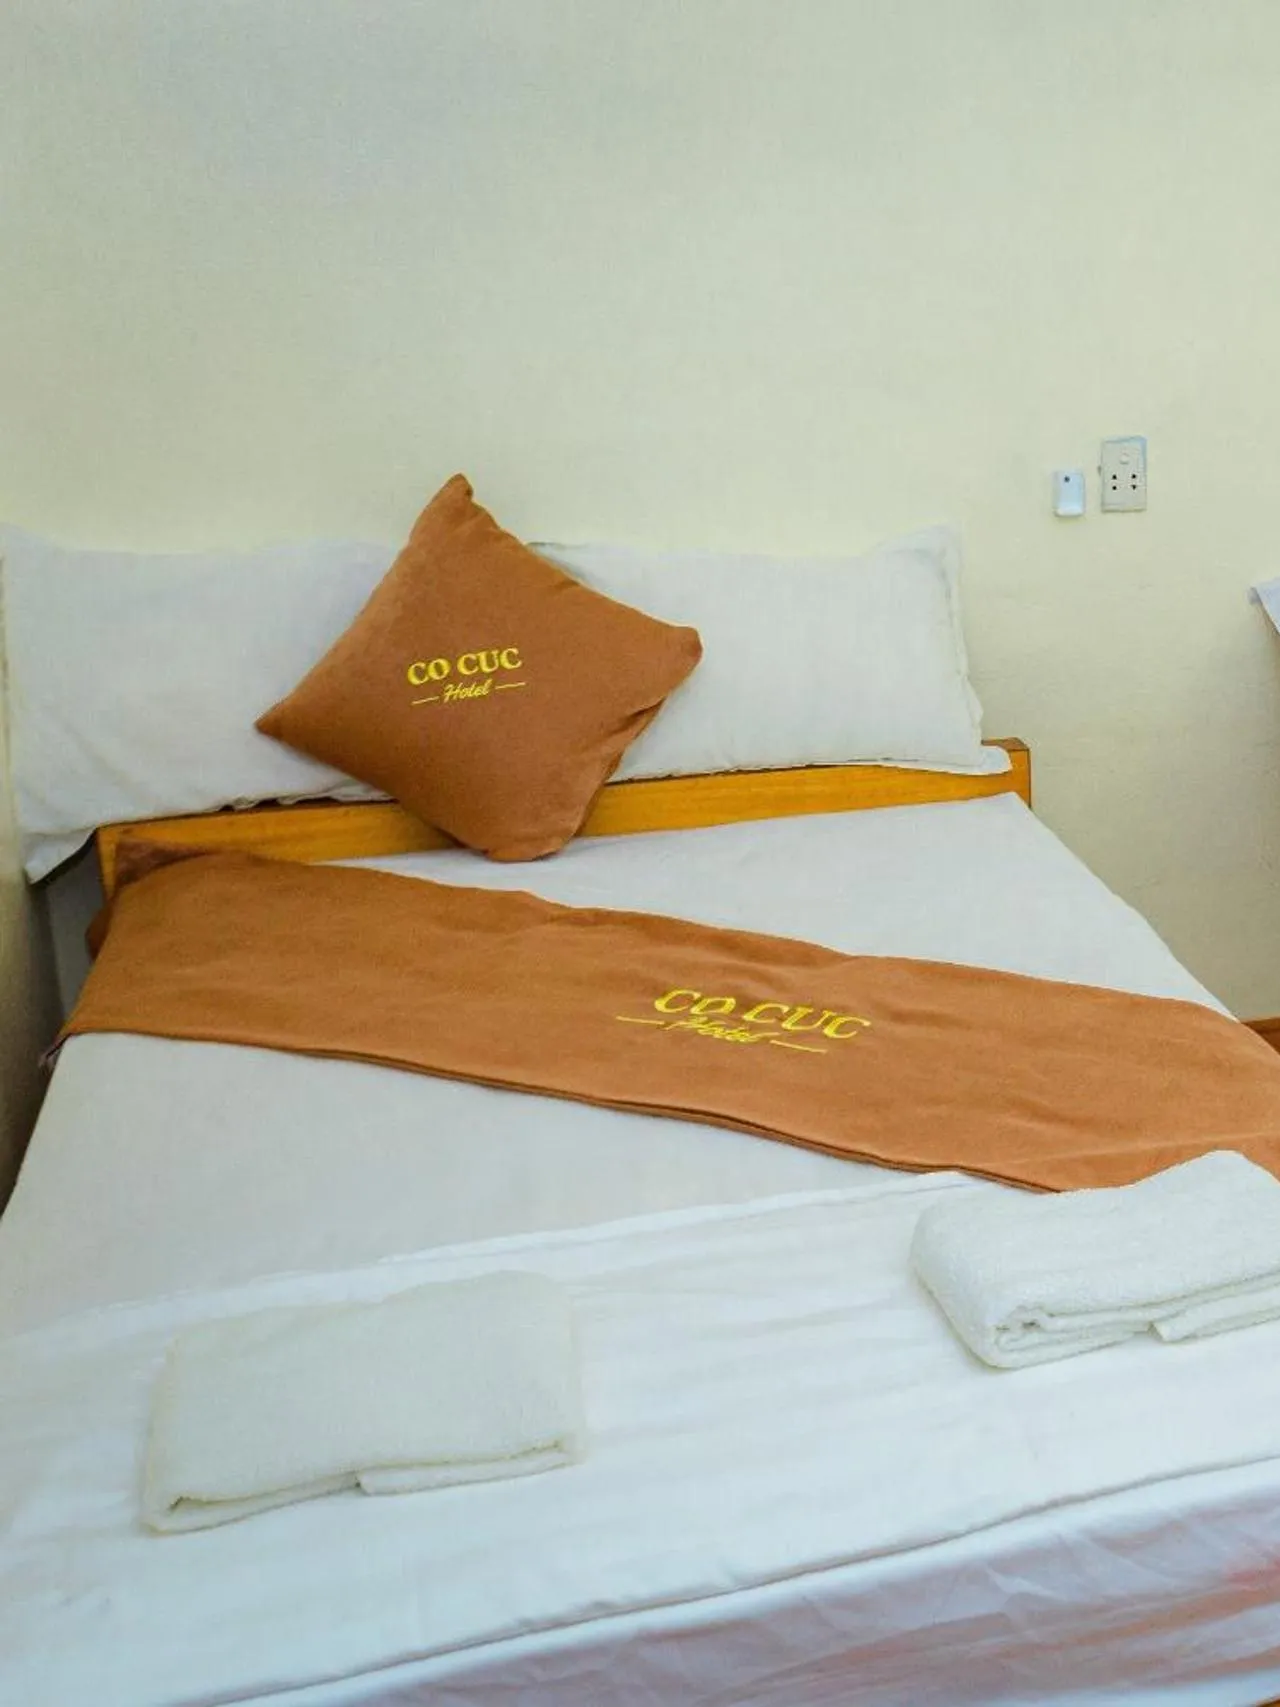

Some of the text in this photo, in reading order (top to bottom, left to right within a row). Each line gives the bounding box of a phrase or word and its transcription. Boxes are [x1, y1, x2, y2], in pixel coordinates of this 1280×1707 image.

[407, 647, 523, 685] CO CUC
[443, 678, 493, 703] Hotel
[654, 989, 871, 1039] CO CUC
